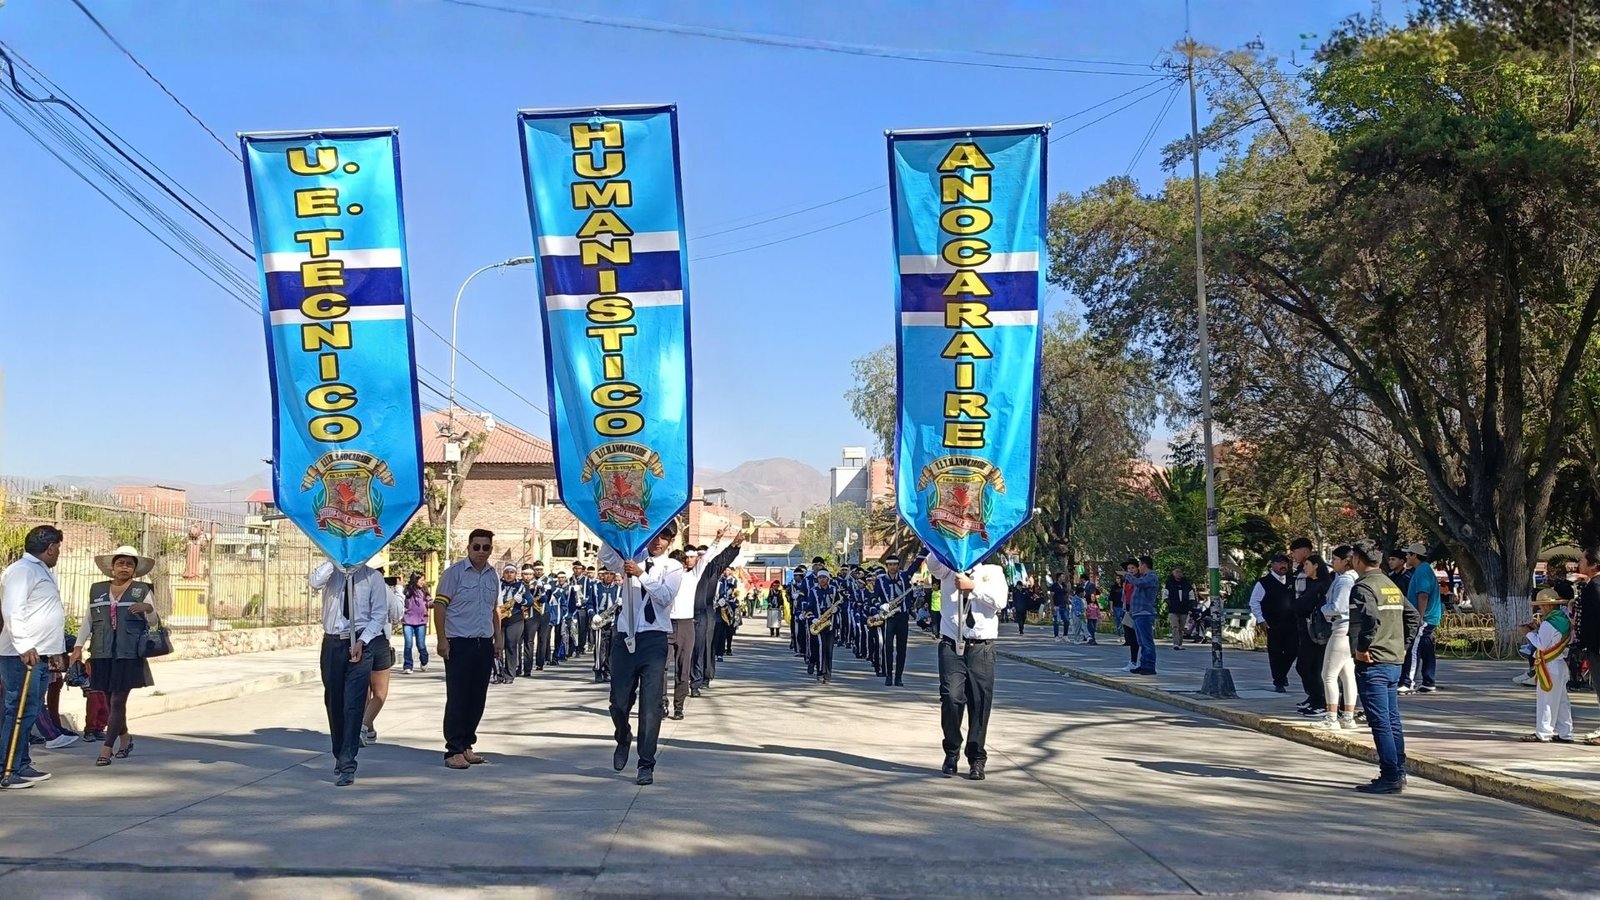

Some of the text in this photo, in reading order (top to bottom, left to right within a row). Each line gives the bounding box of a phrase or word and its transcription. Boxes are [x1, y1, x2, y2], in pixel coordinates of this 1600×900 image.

[286, 146, 361, 177] U.
[294, 187, 364, 218] E.
[294, 228, 362, 443] TECNICO
[570, 121, 645, 438] HUMANISTICO
[937, 141, 996, 449] ANOCARAIRE
